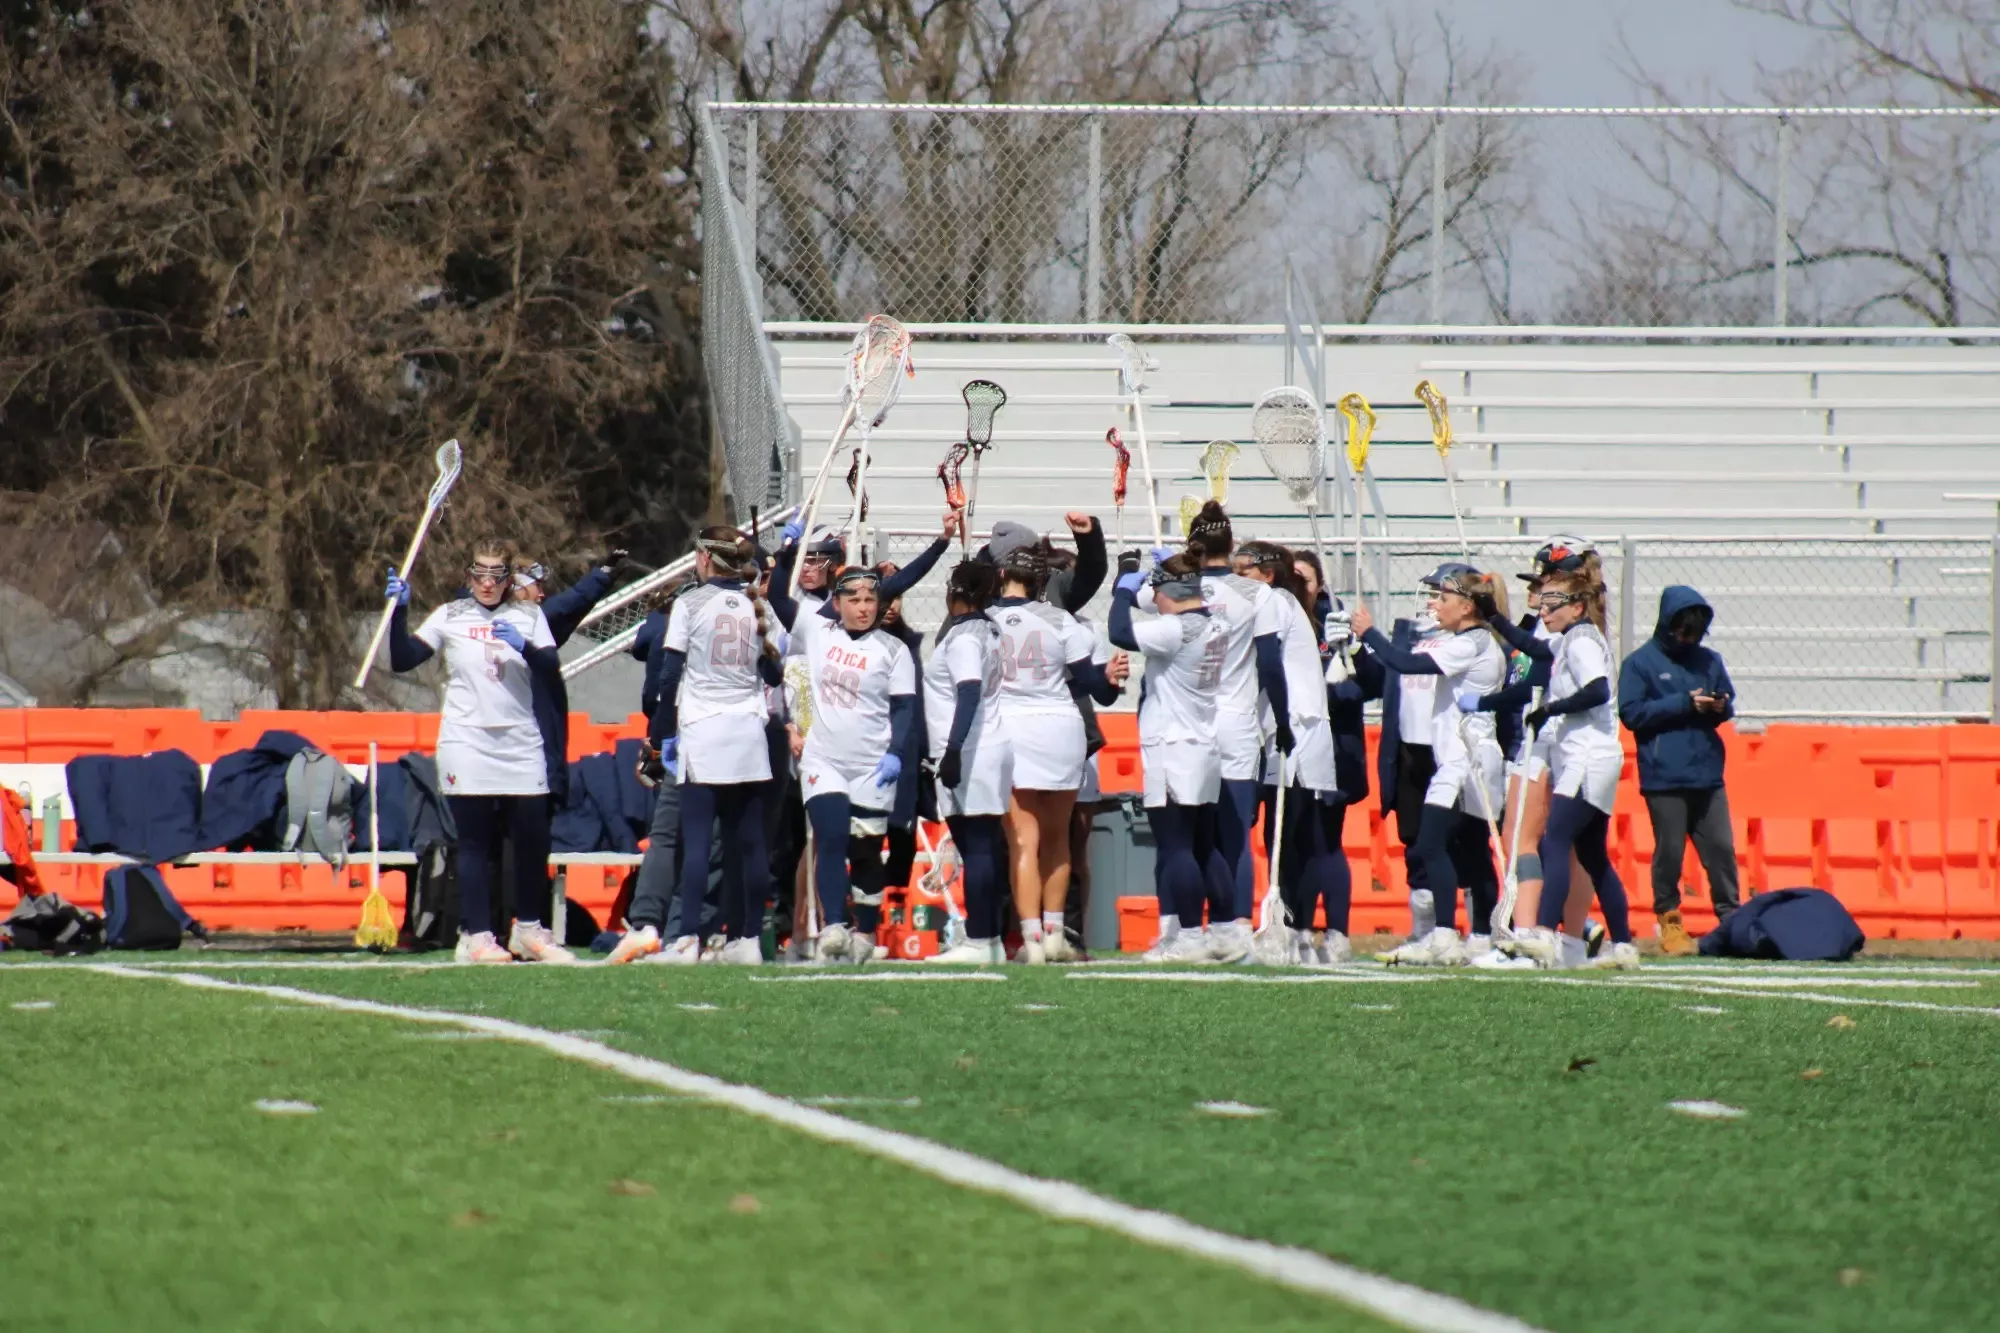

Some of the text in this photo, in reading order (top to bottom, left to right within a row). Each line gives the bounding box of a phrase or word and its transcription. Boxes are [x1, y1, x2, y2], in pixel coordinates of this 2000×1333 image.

[711, 614, 751, 665] 21
[826, 645, 867, 671] UTICA
[904, 934, 921, 955] G
